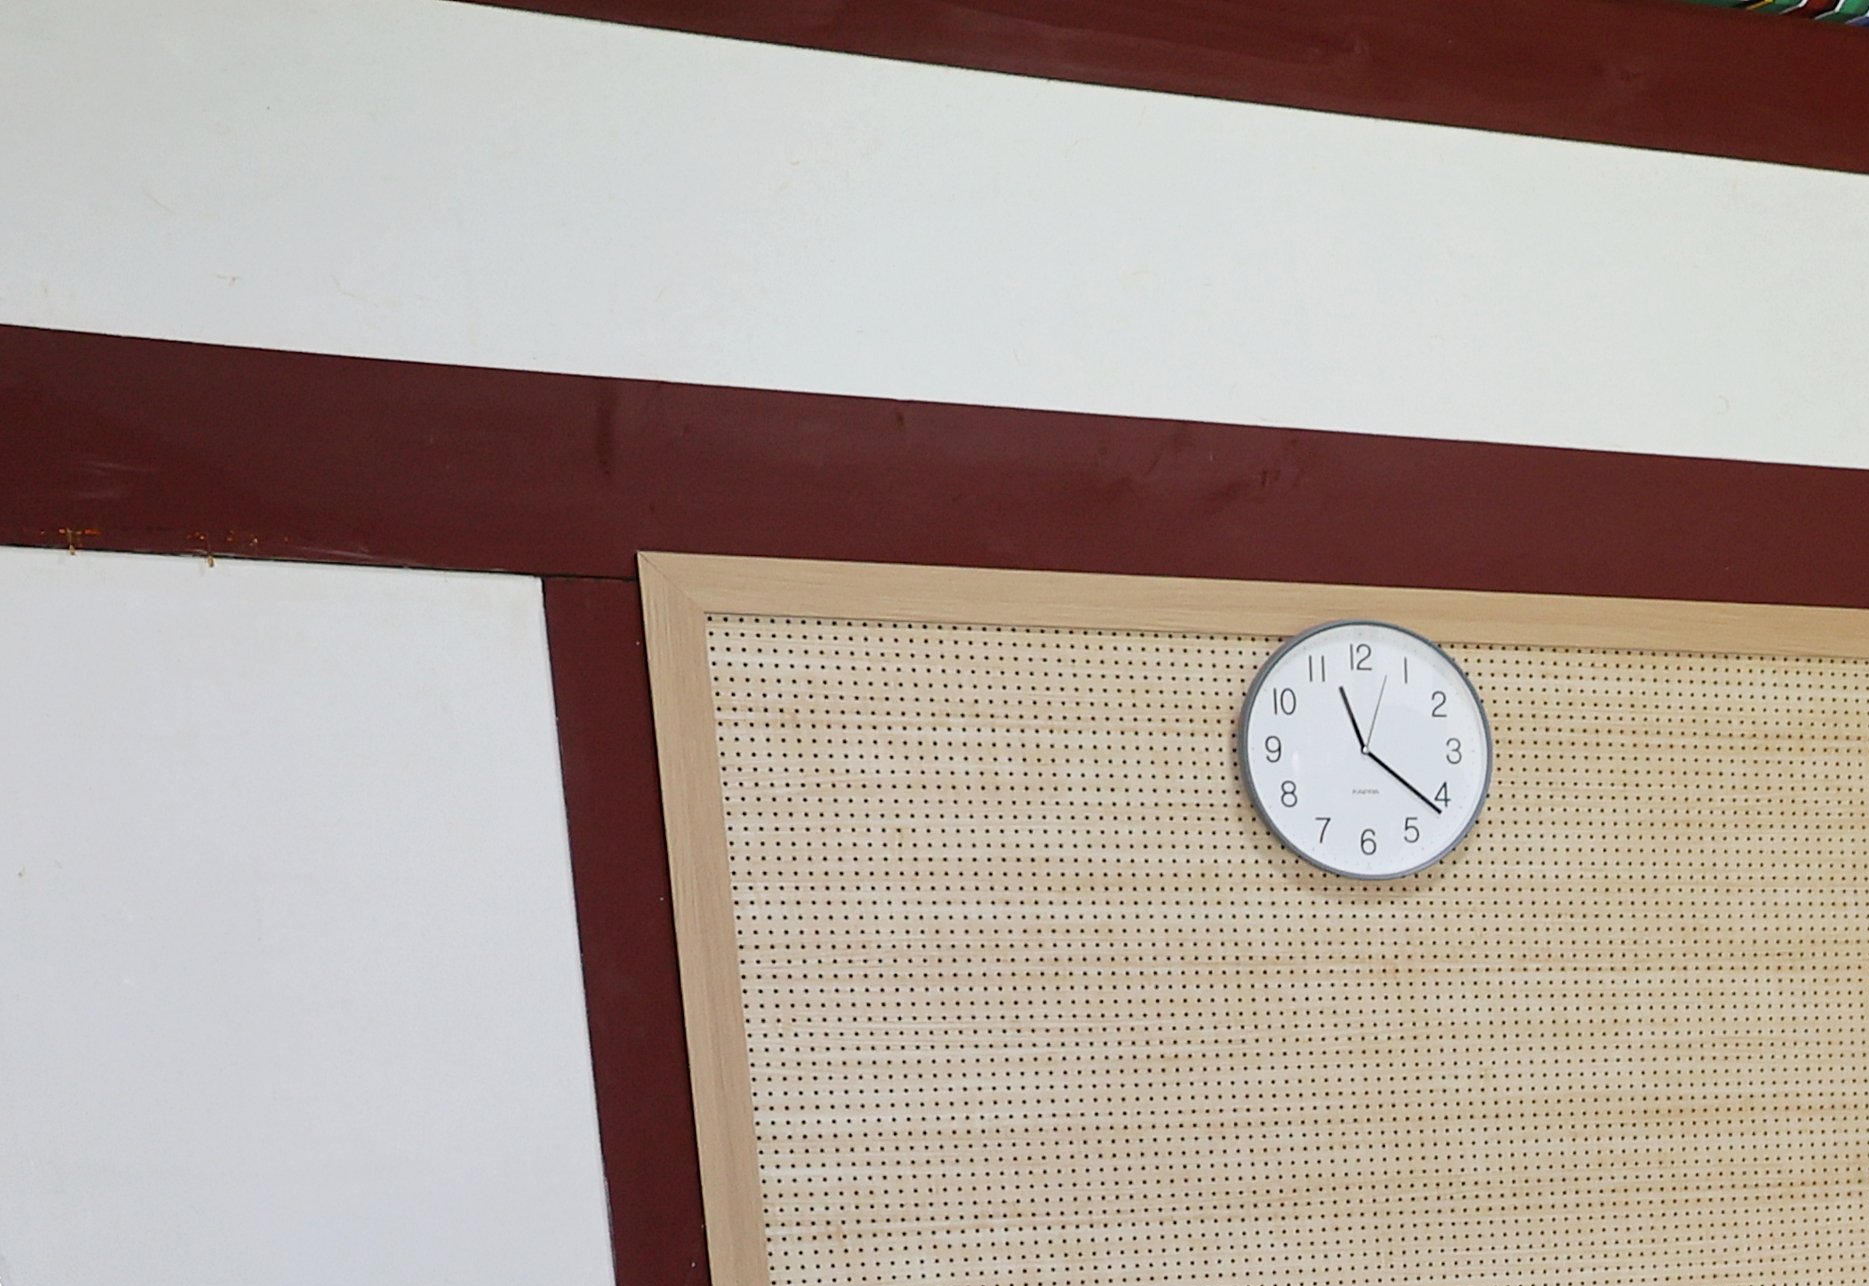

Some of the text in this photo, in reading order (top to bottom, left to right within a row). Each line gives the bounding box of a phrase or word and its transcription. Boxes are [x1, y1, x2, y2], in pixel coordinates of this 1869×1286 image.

[1308, 655, 1325, 682] 11
[1349, 643, 1373, 671] 12
[1403, 657, 1409, 684] 1
[1273, 687, 1297, 715] 10
[1431, 691, 1448, 718] 2
[1264, 736, 1282, 763] 9
[1446, 737, 1463, 765] 3
[1280, 780, 1298, 808] 8
[1434, 781, 1452, 808] 4
[1315, 817, 1331, 844] 7
[1360, 828, 1377, 855] 6
[1403, 817, 1420, 844] 5
